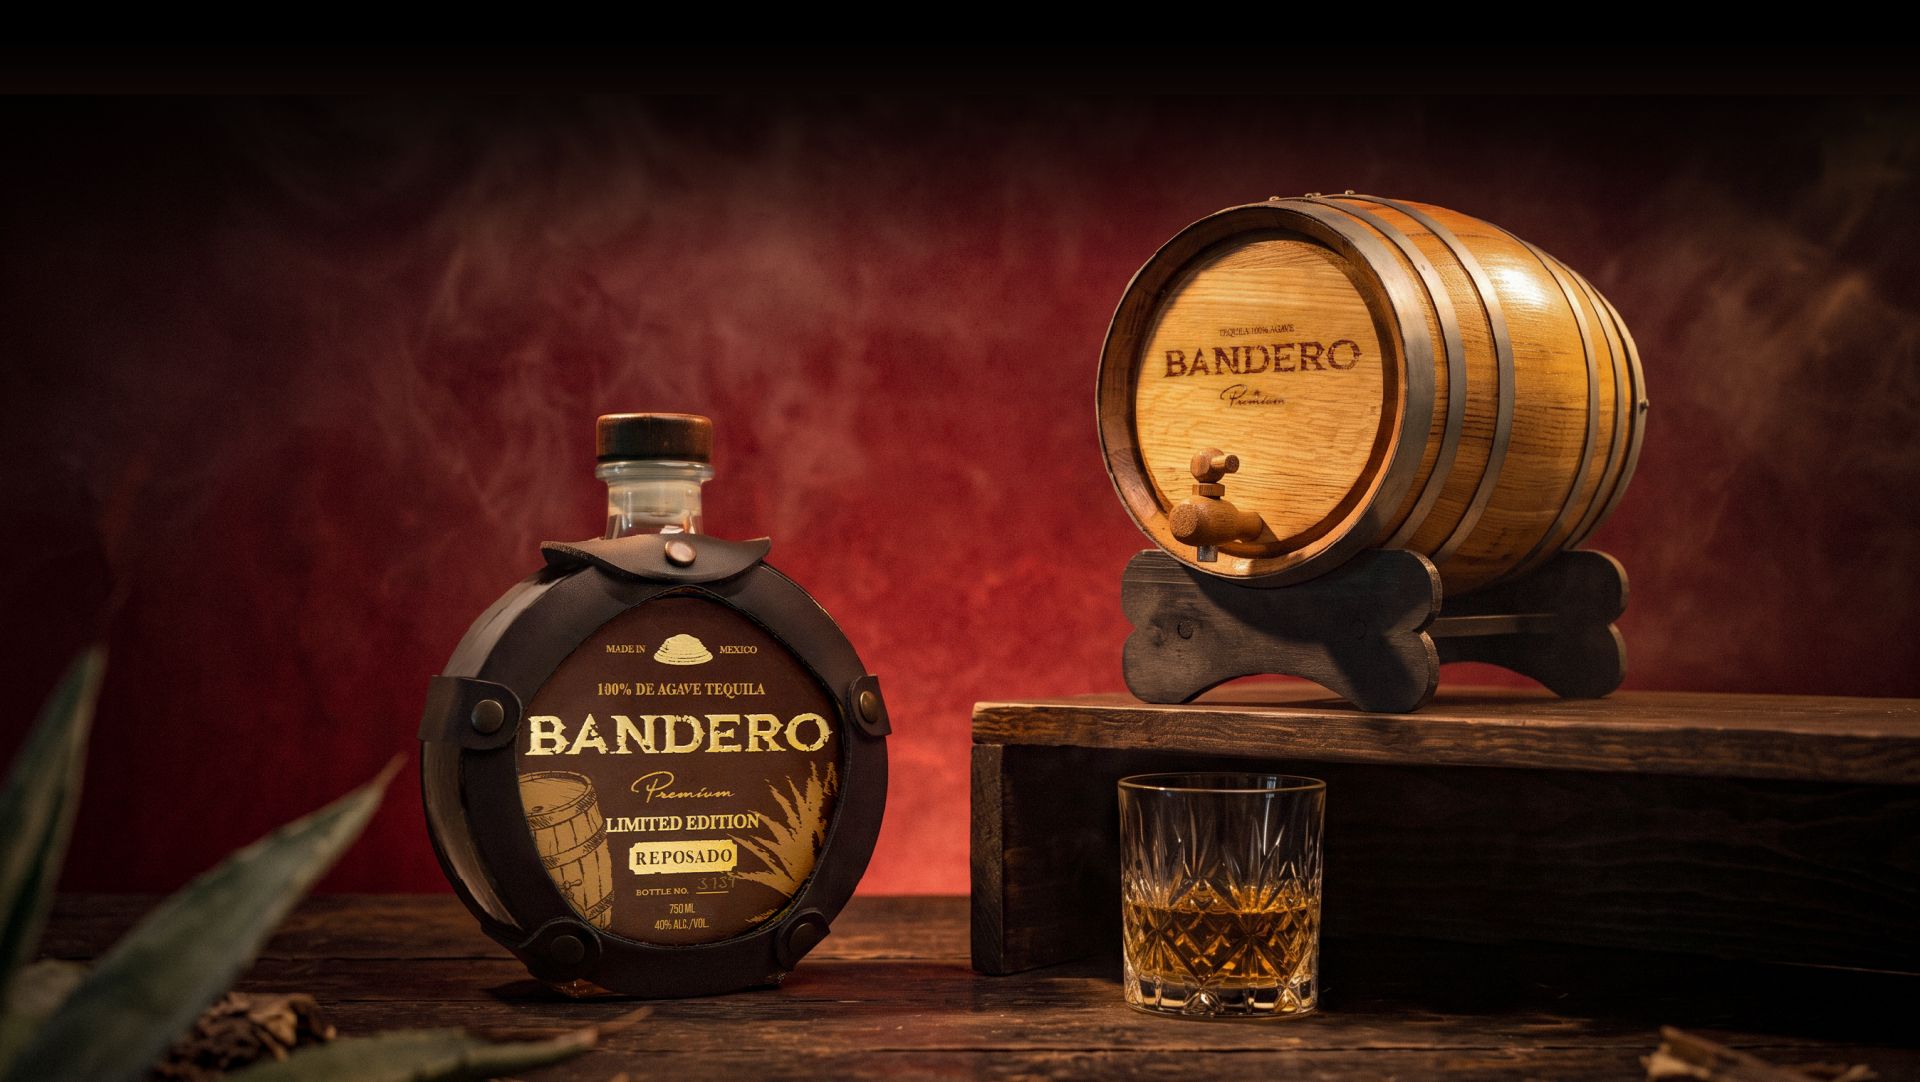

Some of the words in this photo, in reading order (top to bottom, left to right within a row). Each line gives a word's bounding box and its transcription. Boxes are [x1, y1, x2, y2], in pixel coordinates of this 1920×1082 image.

[1251, 326, 1269, 335] 100%
[1270, 324, 1295, 334] AGAVE
[1164, 339, 1363, 378] BANDERO
[1220, 384, 1286, 408] Premium
[606, 644, 634, 653] MADE
[635, 644, 646, 653] IN
[720, 645, 758, 654] MEXICO
[597, 682, 632, 696] 100%
[636, 683, 654, 696] DE
[657, 683, 702, 696] AGAVE
[705, 683, 766, 698] TEQUILA
[525, 712, 833, 756] BANDERO
[630, 770, 735, 804] Premium
[605, 815, 682, 833] LIMITED
[686, 813, 760, 831] EDITION
[635, 848, 733, 866] REPOSADO
[636, 888, 671, 896] BOTTLE
[673, 887, 689, 895] NO.
[669, 903, 684, 914] 750
[684, 903, 696, 914] ML
[654, 919, 672, 931] 40%
